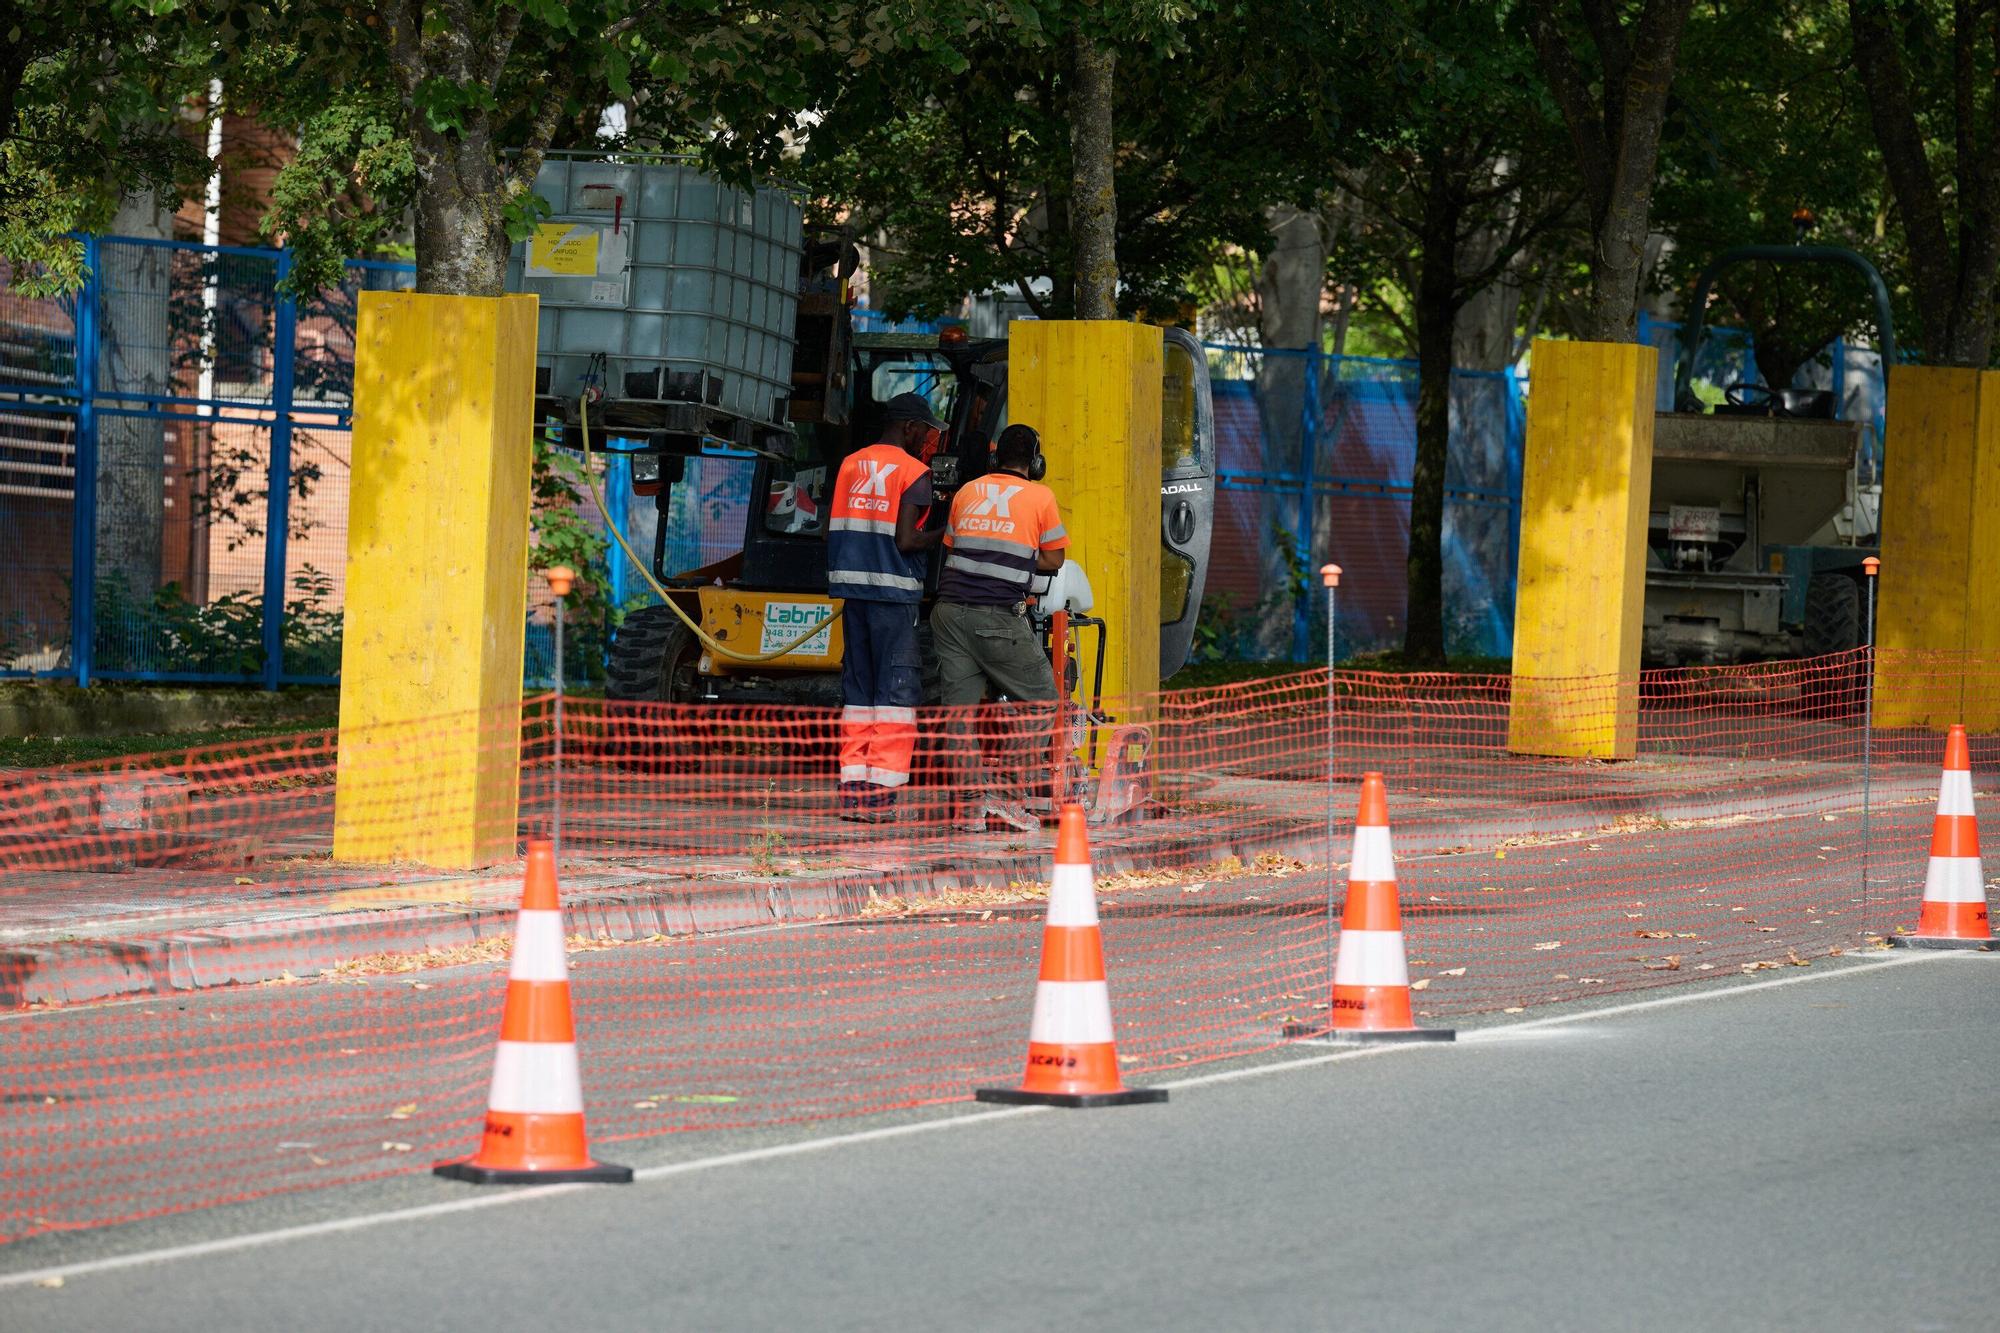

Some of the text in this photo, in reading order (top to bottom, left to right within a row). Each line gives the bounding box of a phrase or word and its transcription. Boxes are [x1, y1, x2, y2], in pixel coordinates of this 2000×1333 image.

[1160, 483, 1203, 495] ADALL
[767, 604, 831, 625] Labrit
[786, 629, 798, 638] 31
